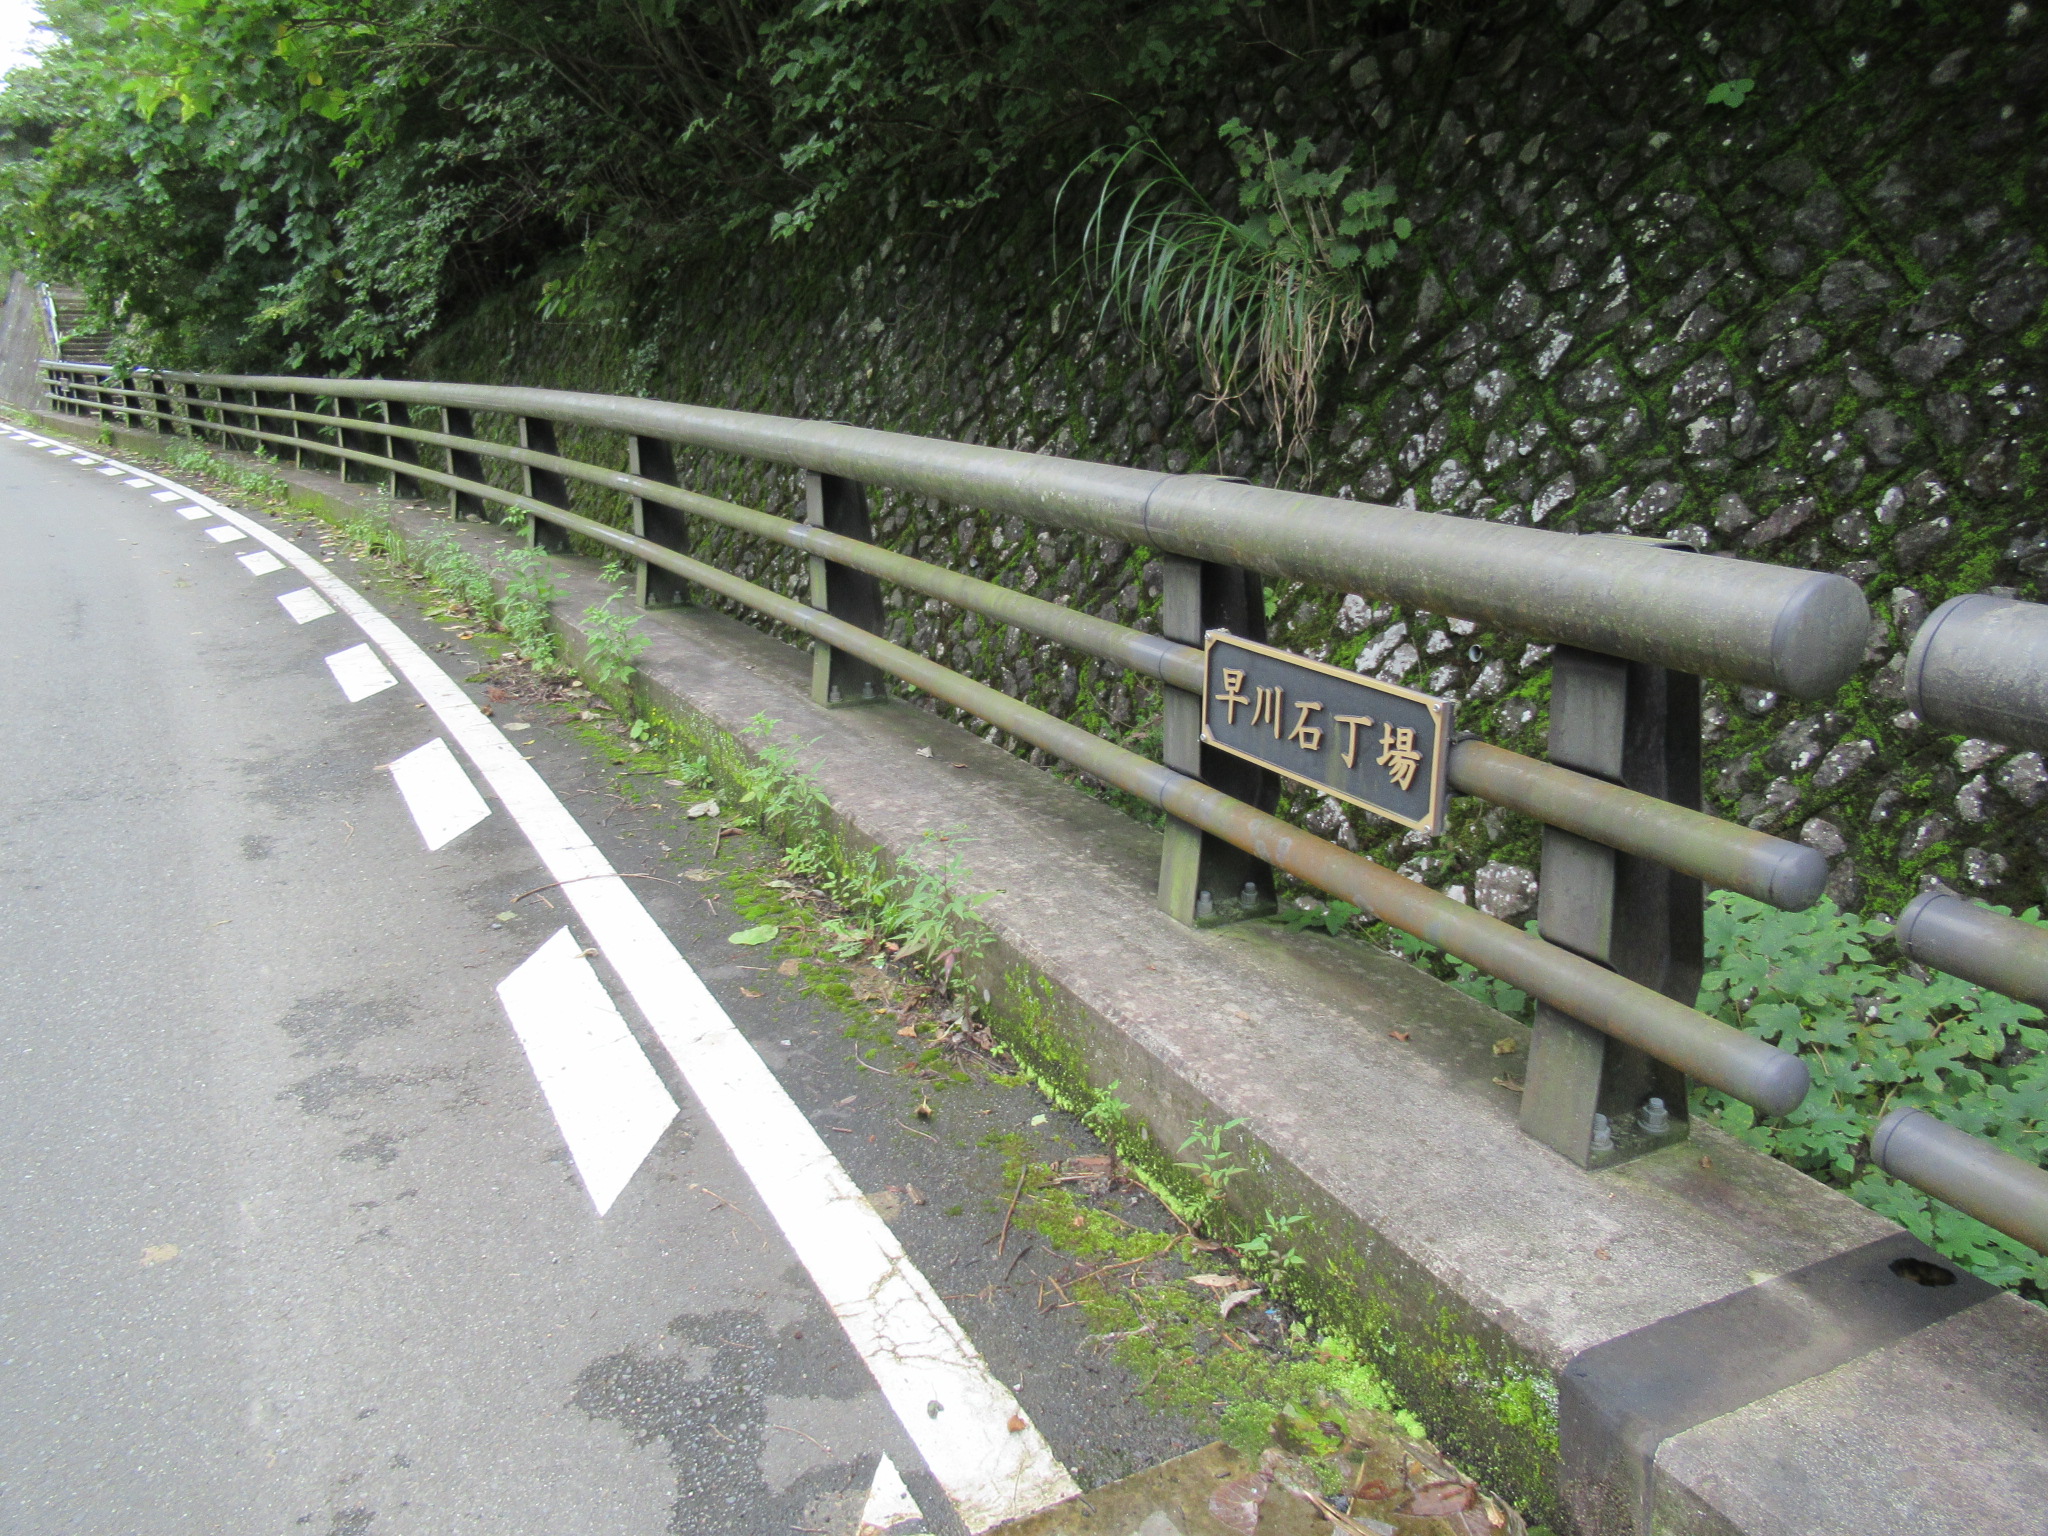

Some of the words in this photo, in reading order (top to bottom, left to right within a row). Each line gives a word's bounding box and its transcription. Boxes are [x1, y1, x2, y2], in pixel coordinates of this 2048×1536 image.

[1215, 667, 1423, 791] 早川石丁場
